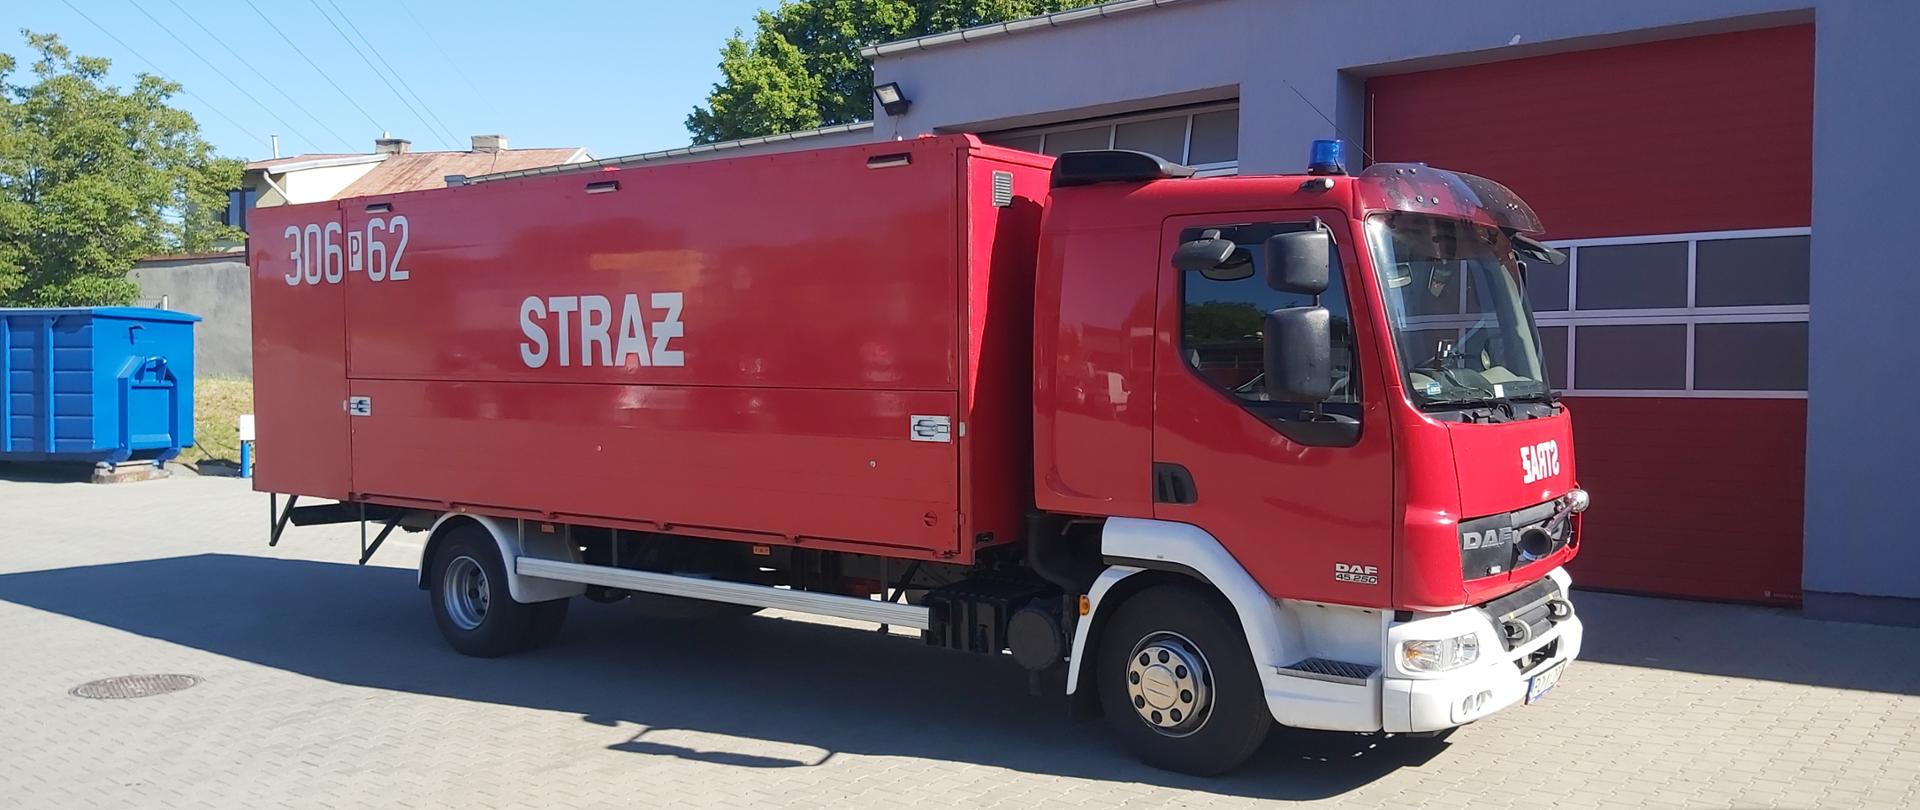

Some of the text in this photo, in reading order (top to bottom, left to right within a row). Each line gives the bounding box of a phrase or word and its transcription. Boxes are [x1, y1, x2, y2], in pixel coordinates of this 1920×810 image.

[284, 221, 344, 286] 306
[367, 215, 410, 282] 62
[1335, 563, 1378, 575] DAF
